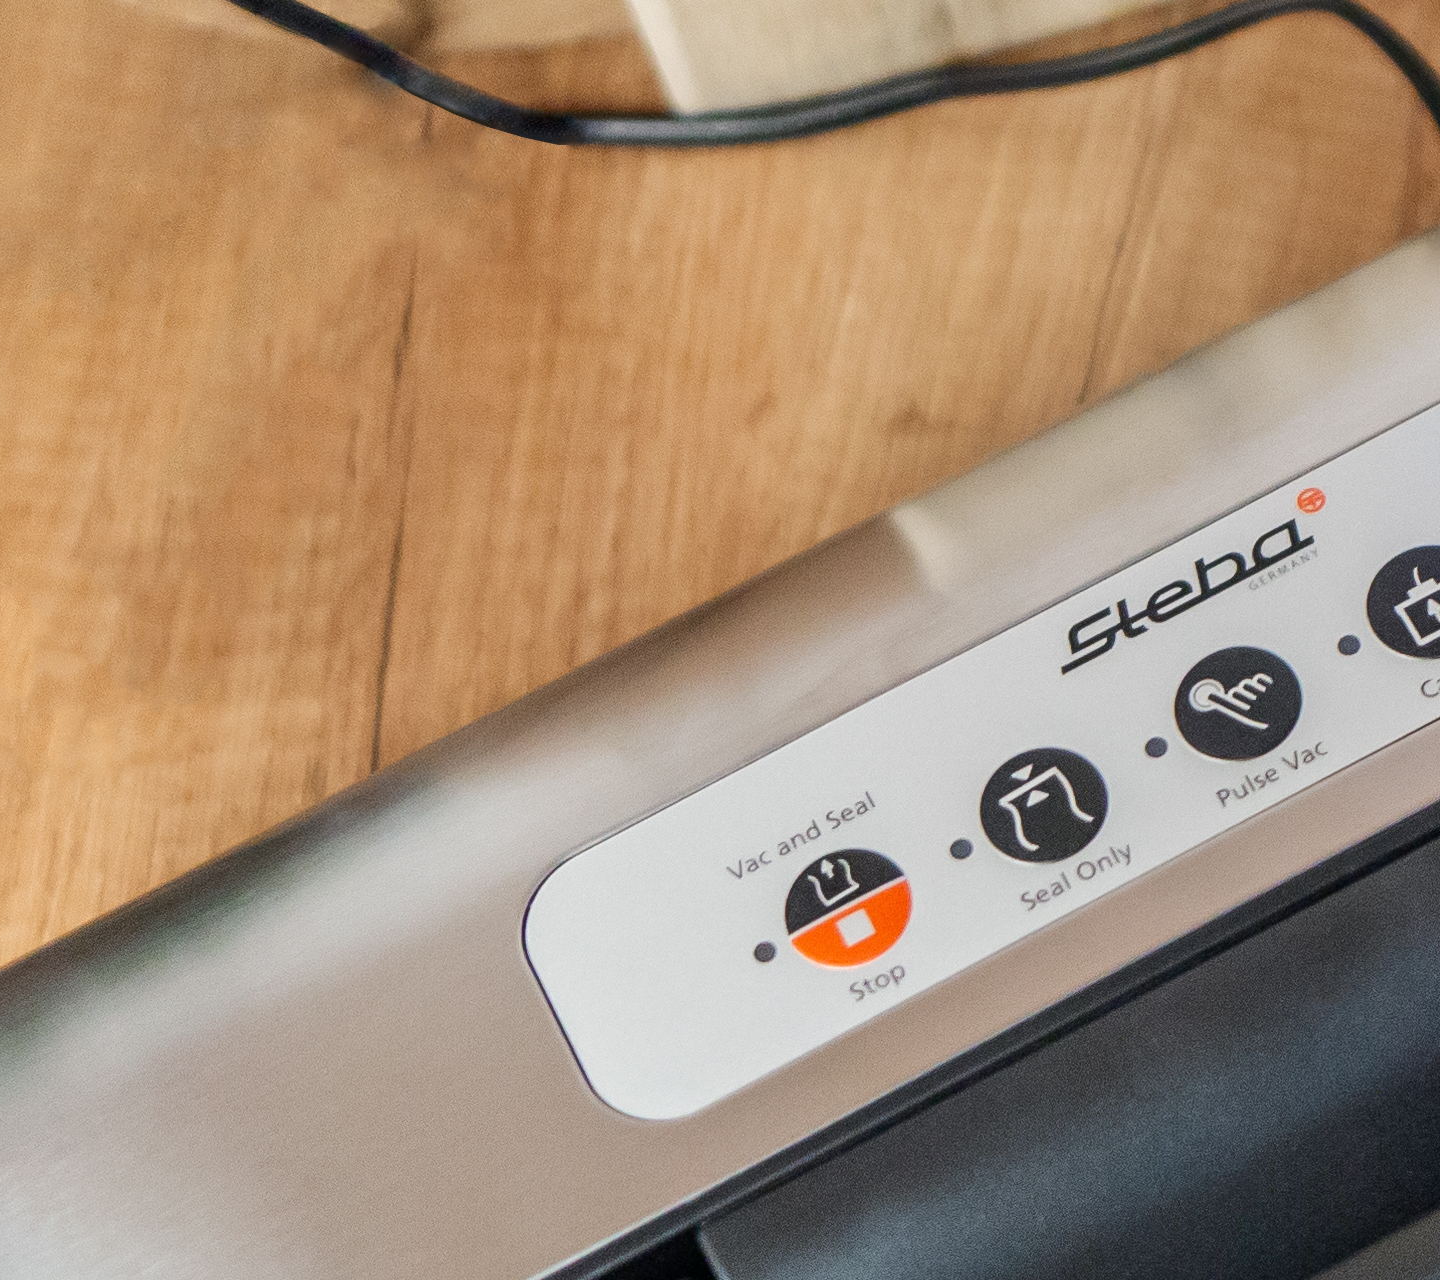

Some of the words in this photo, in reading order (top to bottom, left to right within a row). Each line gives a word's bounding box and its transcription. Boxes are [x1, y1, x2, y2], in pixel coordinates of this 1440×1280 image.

[1248, 547, 1319, 591] GERMANY
[1215, 767, 1280, 808] Pulse
[1281, 741, 1329, 771] Vac
[725, 850, 773, 880] Vac
[777, 819, 822, 857] and
[825, 790, 877, 830] Seal
[1020, 871, 1072, 912] Seal
[1076, 843, 1132, 881] Only
[849, 964, 906, 1002] Stop
